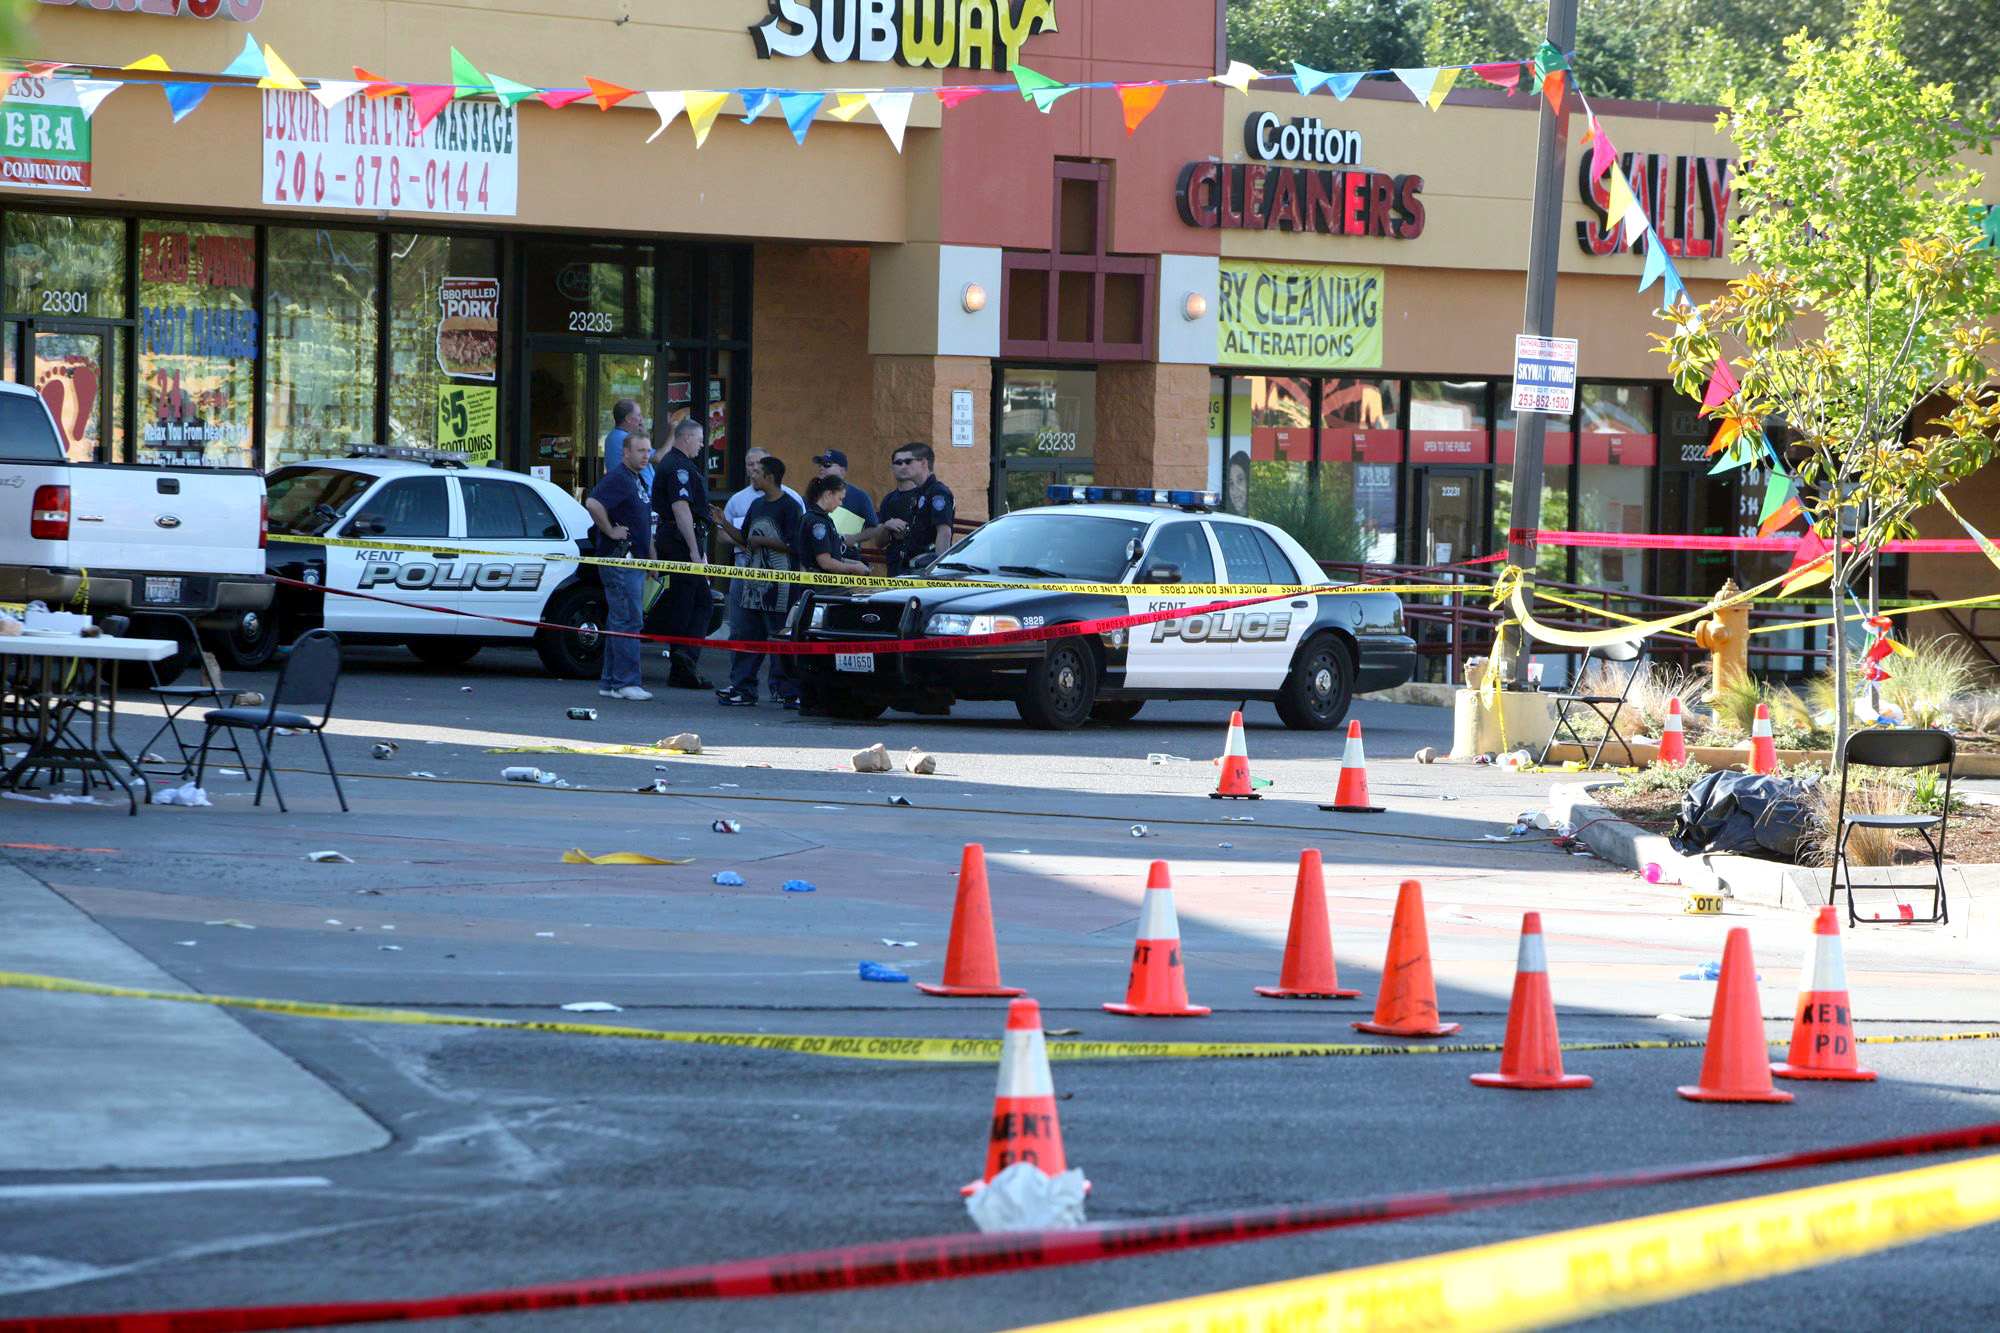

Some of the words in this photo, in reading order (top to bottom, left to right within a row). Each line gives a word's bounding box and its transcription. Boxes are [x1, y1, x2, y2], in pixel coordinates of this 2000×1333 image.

[756, 0, 1059, 72] SUBWAY
[265, 88, 329, 142] LUXURY
[345, 94, 425, 148] HEALTH
[434, 101, 513, 154] MASSAGE
[1255, 111, 1363, 165] Cotton
[3, 161, 82, 182] COMUNION
[275, 149, 489, 211] 206-878-0144
[1184, 160, 1426, 240] CLEANERS
[443, 289, 462, 300] BBQ
[462, 288, 496, 299] PULLED
[1254, 271, 1378, 327] CLEANING
[42, 290, 88, 313] 23301
[448, 300, 492, 318] PORK
[569, 311, 613, 333] 23235
[143, 307, 187, 355] FOOT
[192, 307, 259, 359] MASSAGE
[1224, 330, 1354, 357] ALTERATIONS
[1518, 363, 1547, 382] SKYWAY
[1548, 365, 1574, 384] TOWING
[1519, 393, 1570, 409] 253-852-1500
[441, 389, 469, 438] $5
[144, 423, 166, 441] Relax
[168, 423, 182, 441] You
[184, 423, 202, 441] From
[204, 423, 224, 441] Head
[441, 434, 493, 453] FOOTLONGS
[1038, 432, 1076, 451] 23233
[1424, 441, 1437, 452] OPEN
[1438, 441, 1444, 452] TO
[1445, 441, 1454, 452] THE
[1358, 466, 1391, 486] FREE
[1442, 485, 1460, 496] 23231
[355, 549, 404, 562] KENT
[650, 561, 665, 569] LINE
[666, 563, 691, 572] POLICE
[703, 564, 727, 575] CROSS
[357, 561, 547, 592] POLICE
[728, 567, 744, 577] NOT
[744, 568, 755, 578] DO
[757, 569, 773, 580] LINE
[775, 571, 801, 582] POLICE
[813, 575, 838, 584] CROSS
[839, 576, 856, 585] NOT
[857, 577, 868, 586] DO
[869, 577, 886, 586] LINE
[887, 578, 915, 587] POLICE
[1120, 586, 1147, 594] POLICE
[1161, 585, 1185, 594] CROSS
[1188, 585, 1204, 594] NOT
[1205, 585, 1217, 594] DO
[1219, 585, 1238, 594] LINE
[1237, 585, 1267, 594] POLICE
[1023, 615, 1045, 627] 3828
[1150, 611, 1293, 644] POLICE
[1803, 1003, 1852, 1026] KEN
